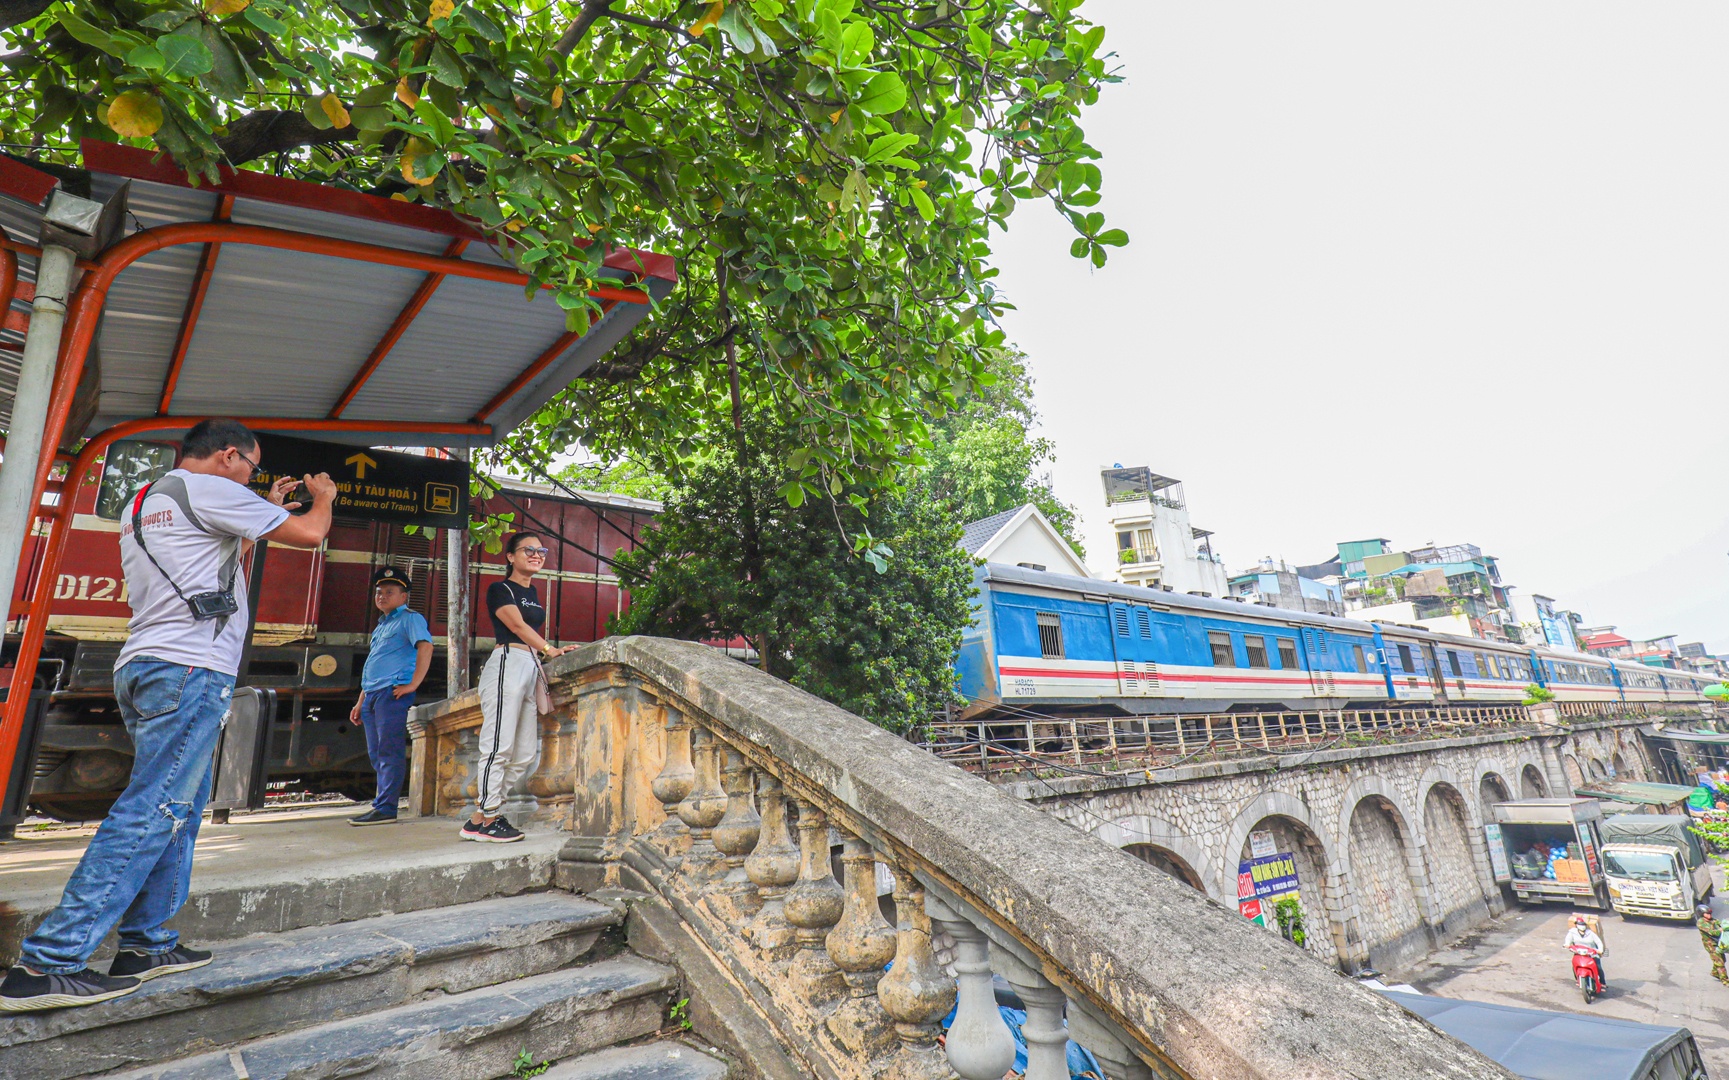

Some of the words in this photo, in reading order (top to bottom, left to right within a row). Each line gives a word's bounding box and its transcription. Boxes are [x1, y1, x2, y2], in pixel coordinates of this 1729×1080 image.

[336, 480, 352, 493] HÚ
[354, 481, 362, 495] Ý
[364, 484, 386, 497] TÀU
[353, 498, 379, 509] aware
[380, 500, 389, 510] of
